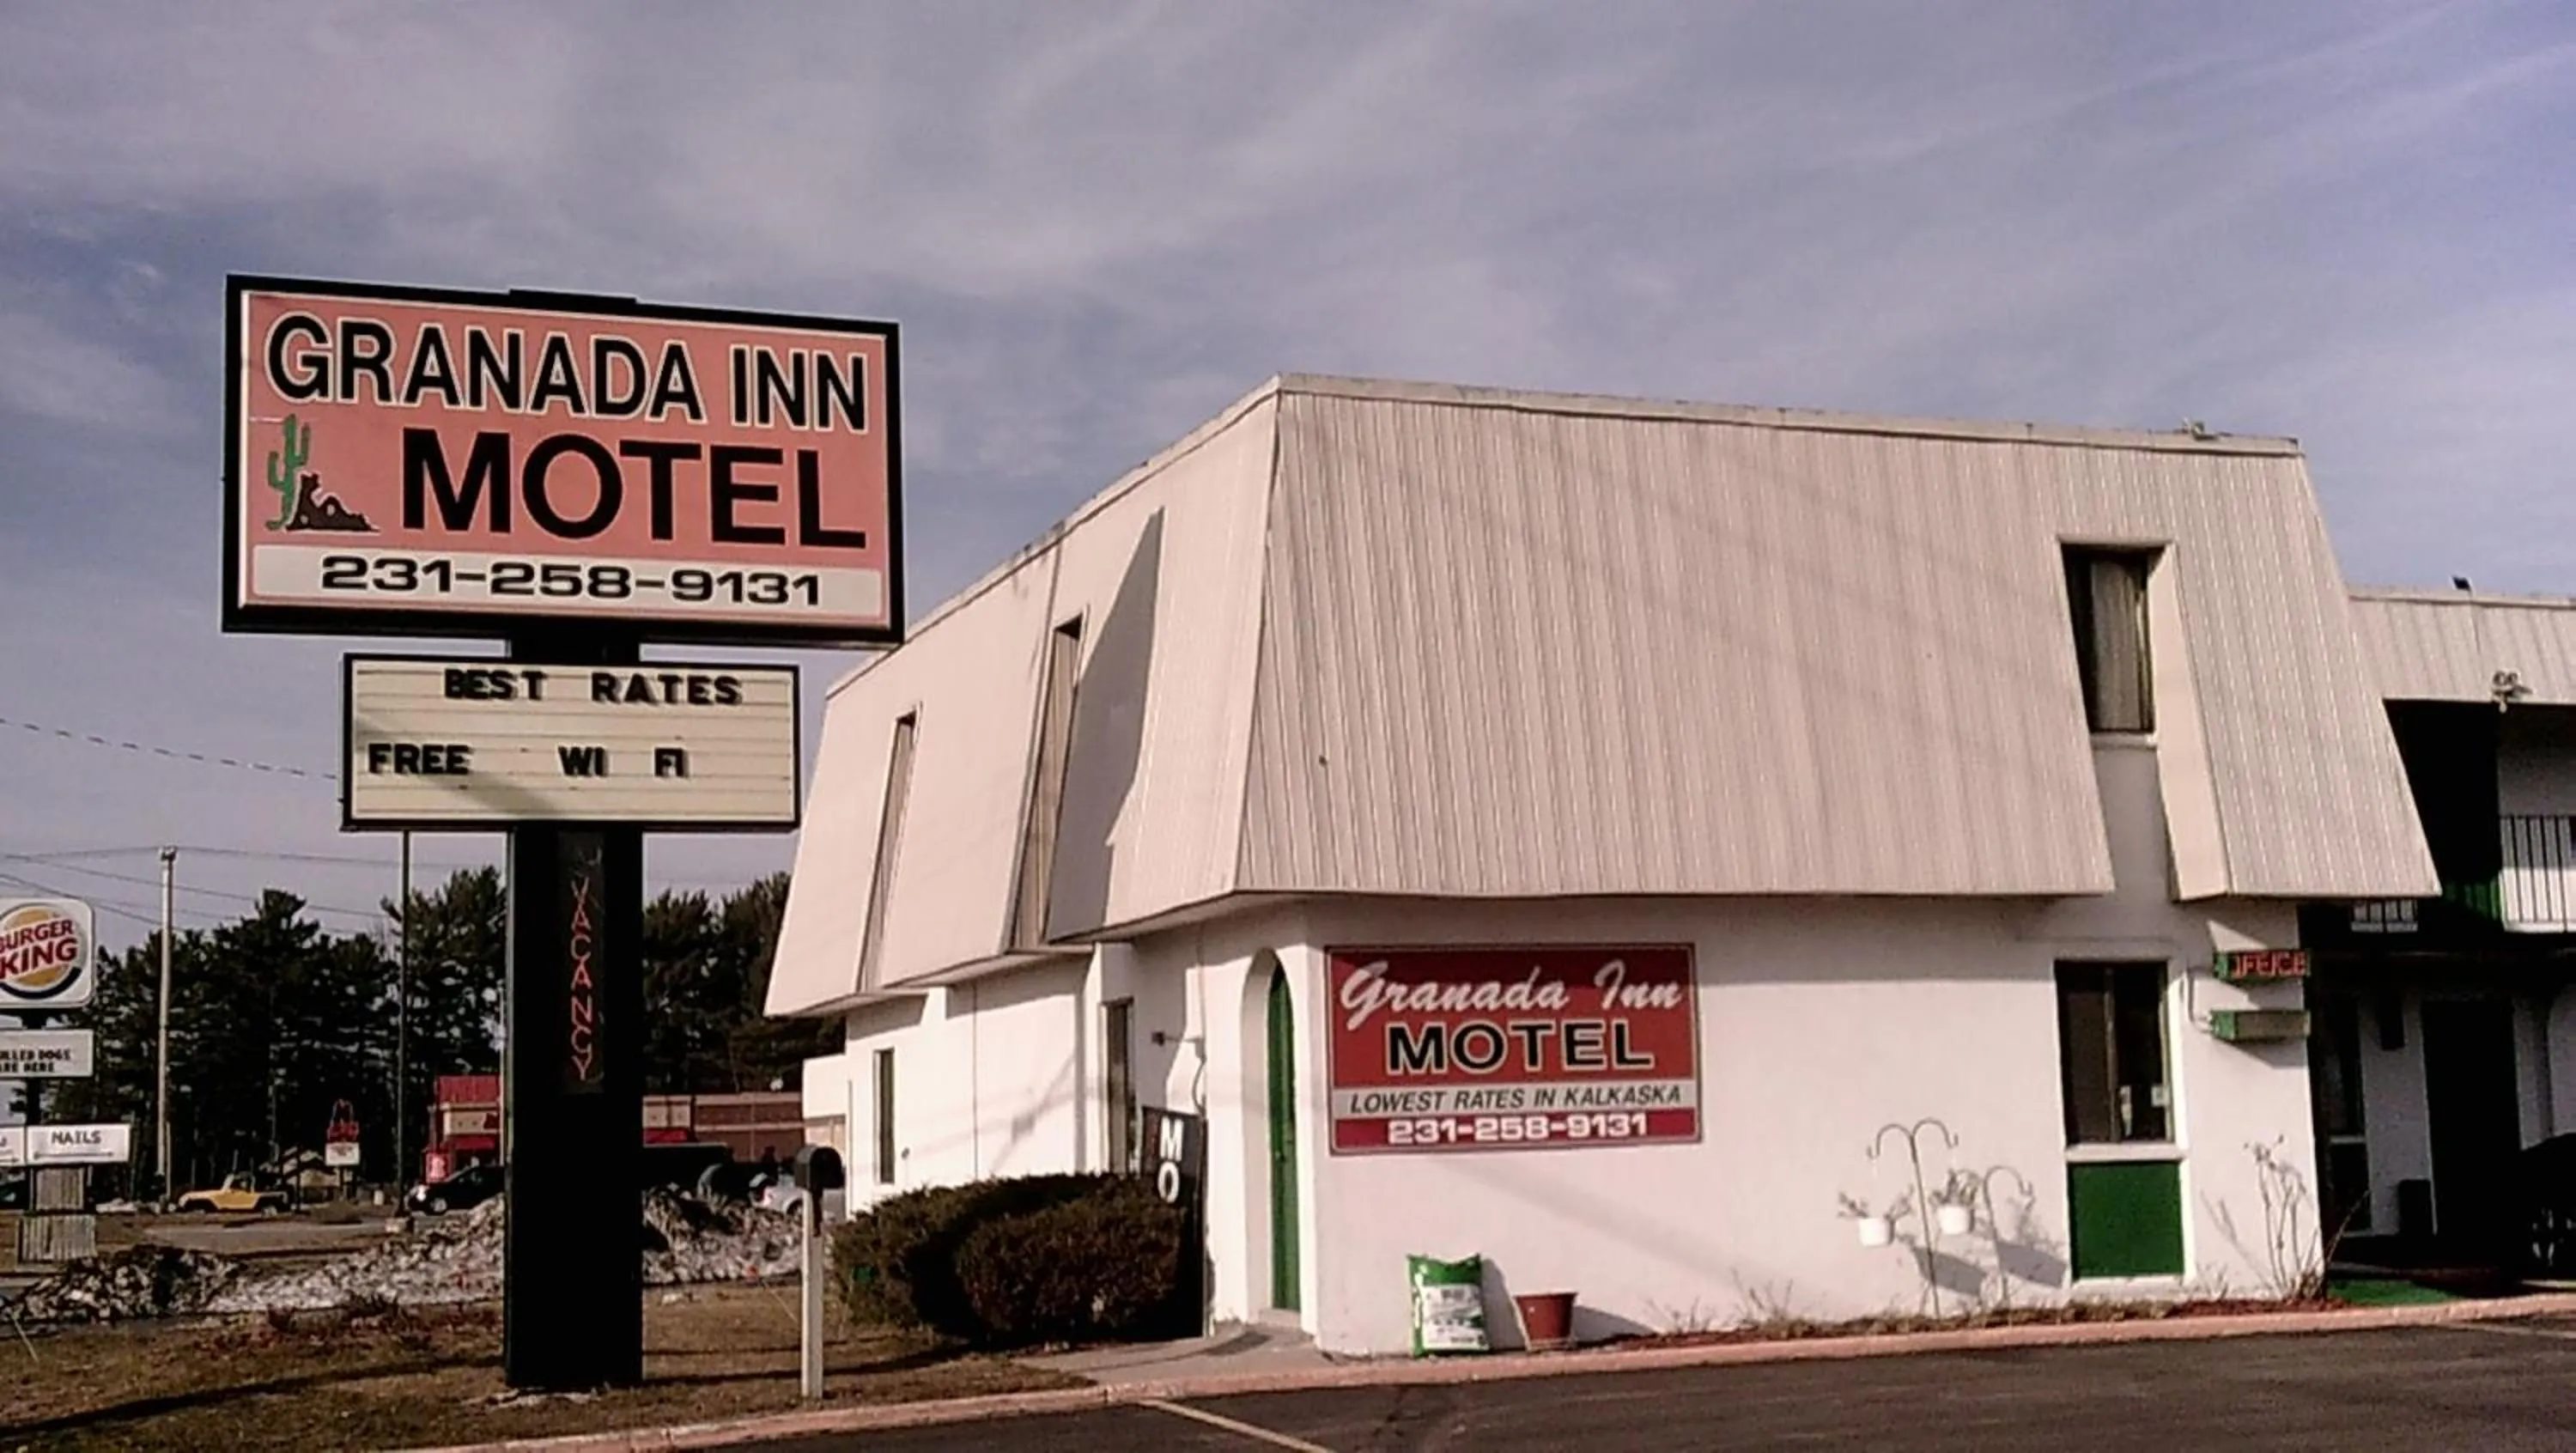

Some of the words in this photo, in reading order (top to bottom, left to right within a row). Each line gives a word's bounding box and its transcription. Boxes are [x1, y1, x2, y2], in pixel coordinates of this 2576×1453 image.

[266, 313, 705, 423] GRANADA
[732, 345, 867, 432] INN
[402, 426, 866, 549] MOTEL
[321, 556, 820, 605] 231-258-9131
[444, 669, 547, 701] BEST
[591, 673, 743, 706] RATES
[368, 744, 472, 776] FREE
[558, 746, 609, 777] WI
[0, 938, 77, 979] KING
[570, 876, 592, 1081] VACANCY
[1340, 961, 1570, 1030] Granada
[1594, 959, 1682, 1010] Inn
[1386, 1018, 1656, 1075] MOTEL
[1350, 1090, 1448, 1113] LOWEST
[1454, 1087, 1524, 1110] RATES
[1533, 1087, 1557, 1108] IN
[1563, 1085, 1682, 1108] KALKASKA
[52, 1130, 101, 1145] NAILS
[1388, 1113, 1648, 1145] 231-258-9131
